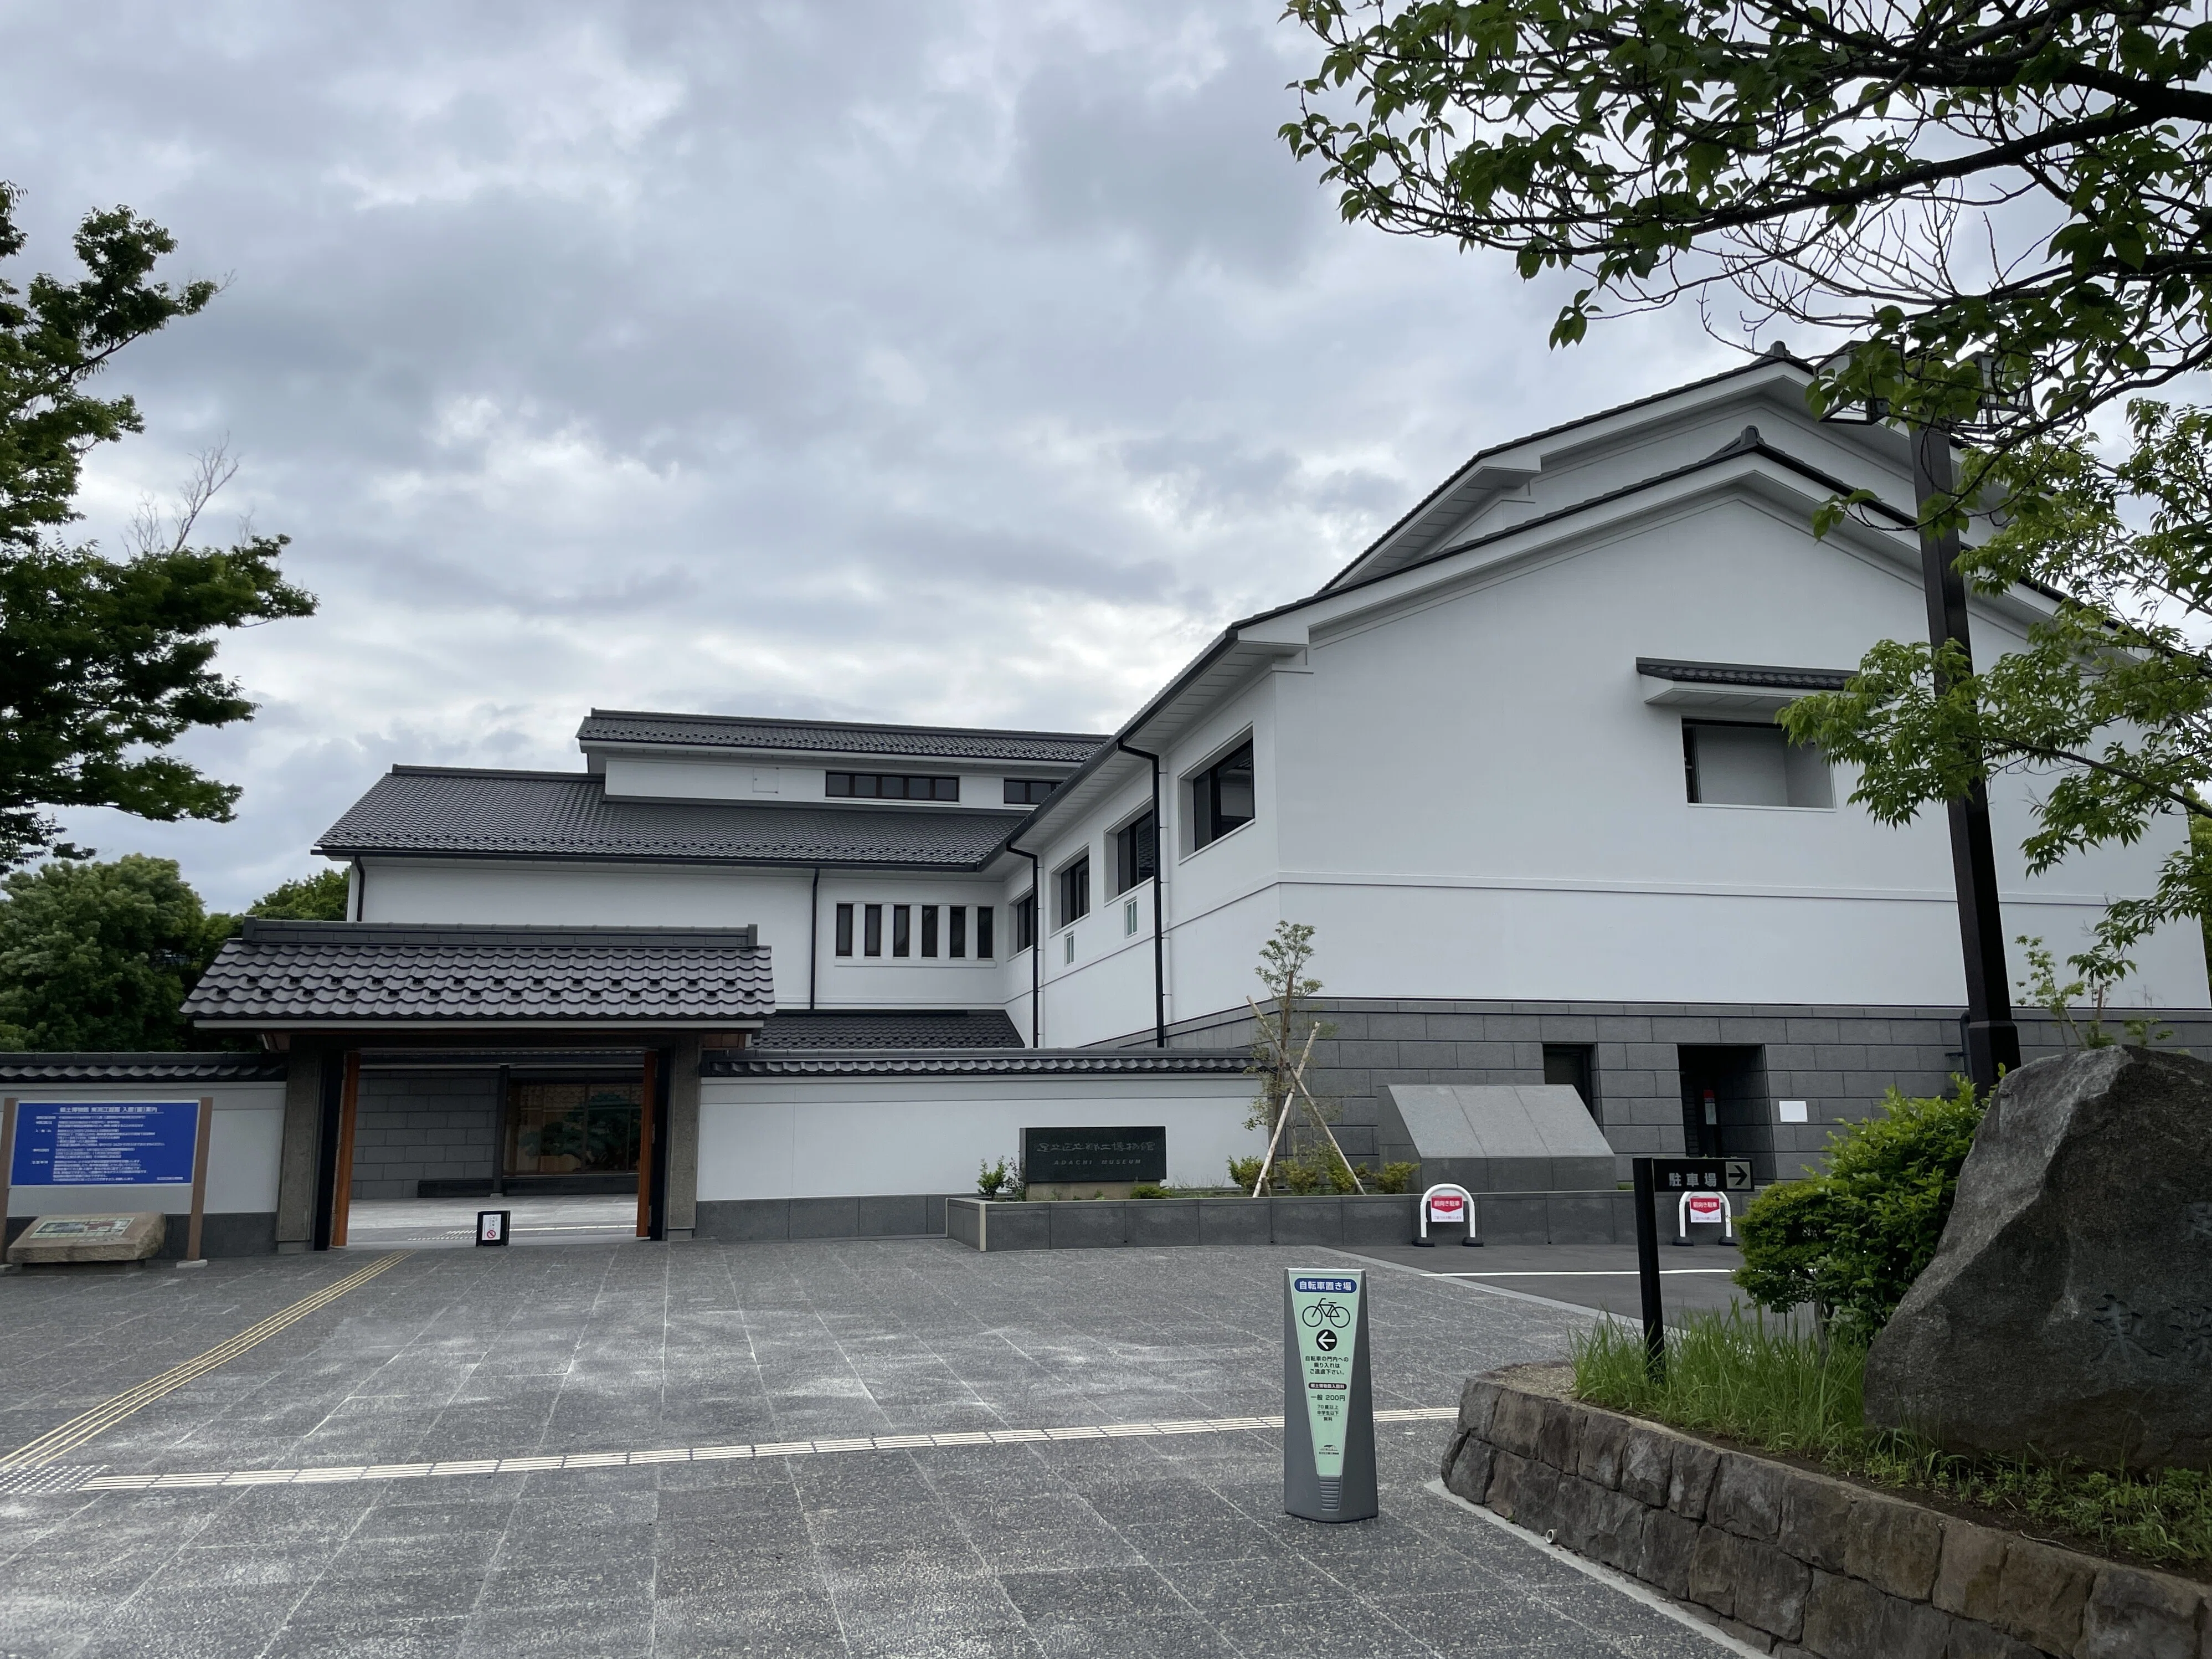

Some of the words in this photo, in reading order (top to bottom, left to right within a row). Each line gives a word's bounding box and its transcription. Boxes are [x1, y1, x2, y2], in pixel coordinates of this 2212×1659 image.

[1669, 1173, 1717, 1187] 駐車場
[1299, 1281, 1352, 1291] 自転車置き場
